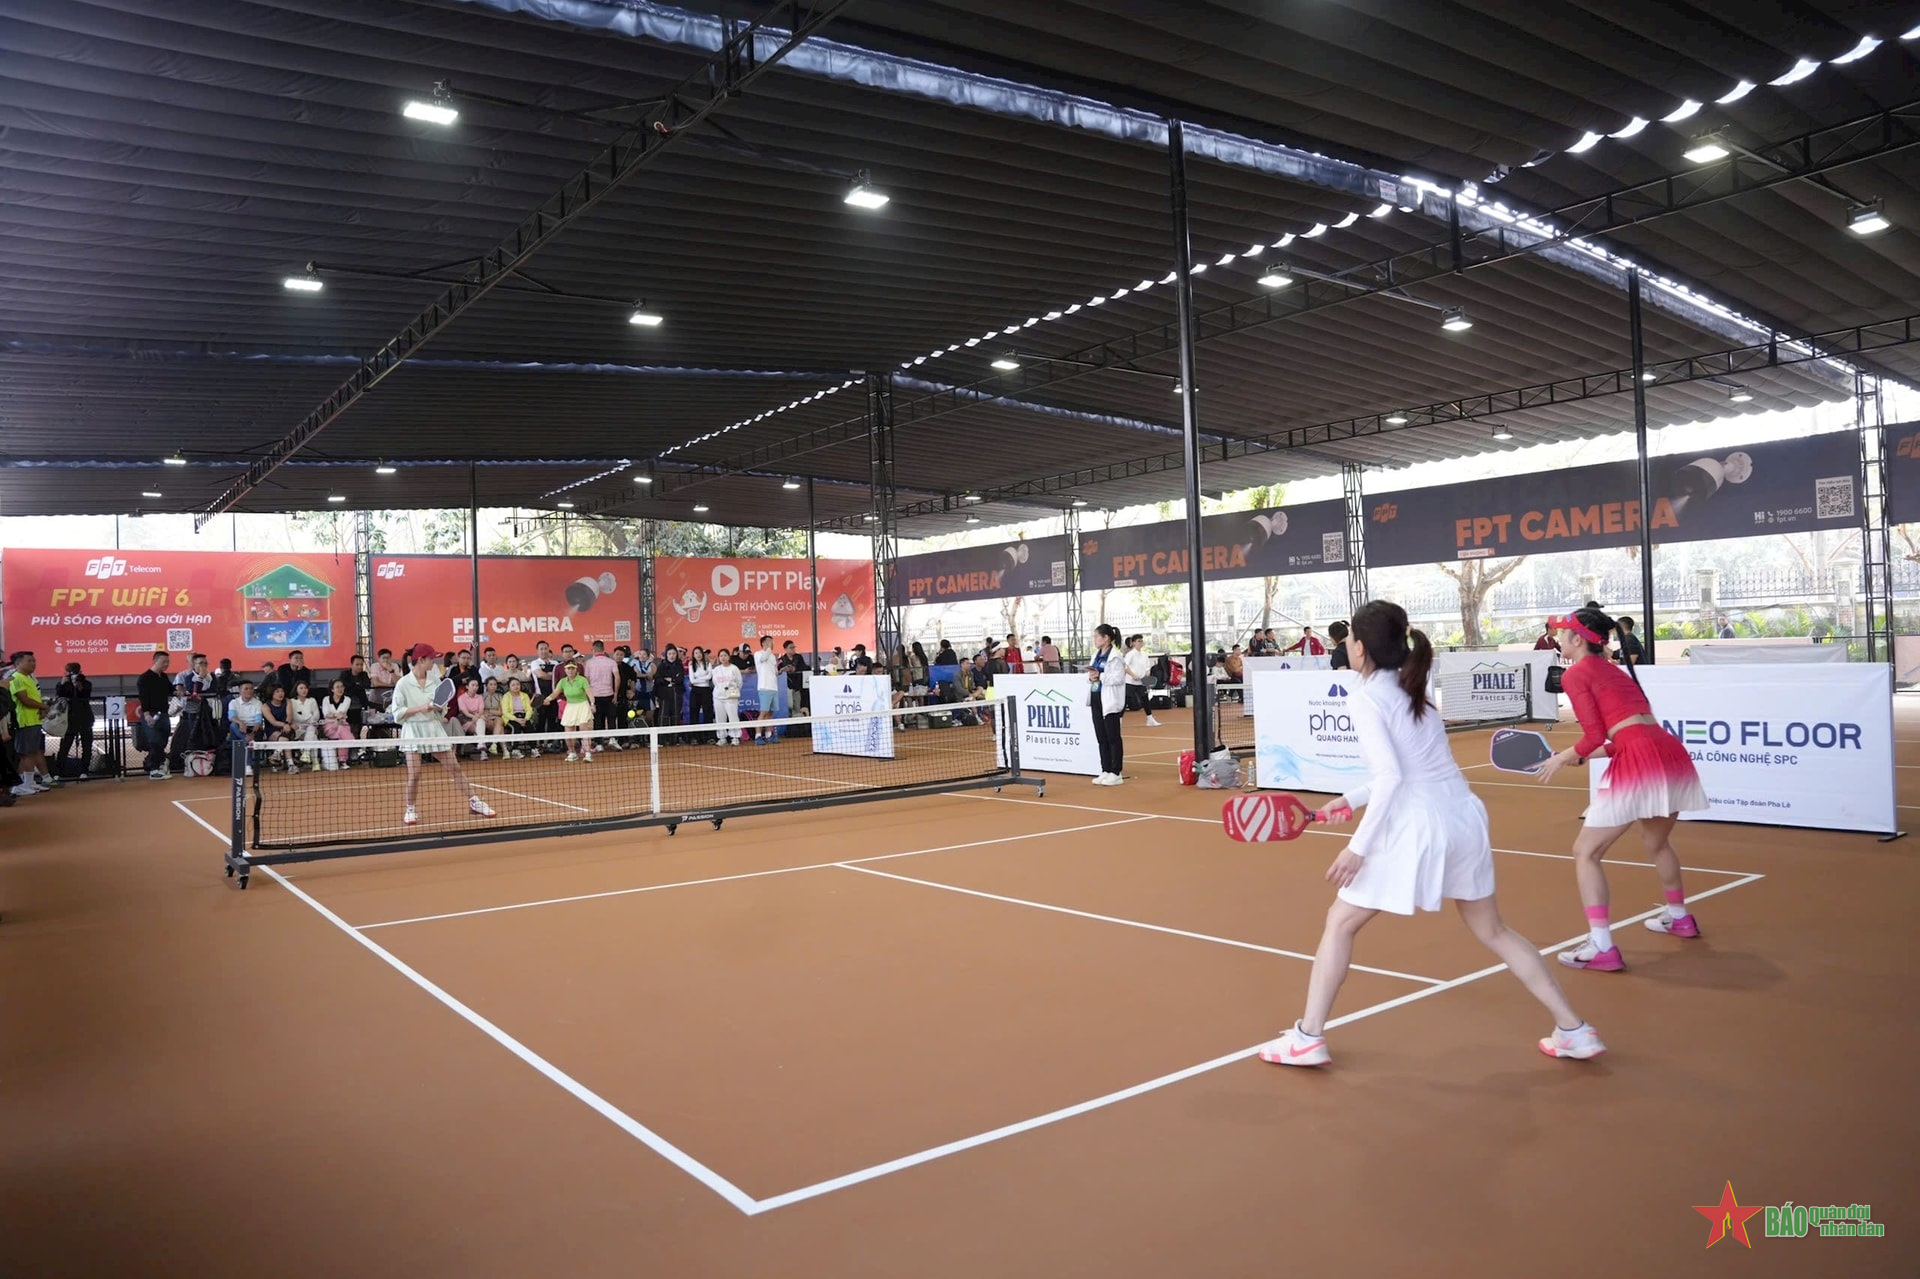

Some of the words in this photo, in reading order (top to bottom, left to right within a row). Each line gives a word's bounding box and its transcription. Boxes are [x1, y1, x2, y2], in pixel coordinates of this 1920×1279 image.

[1373, 503, 1397, 523] FPT
[1776, 508, 1793, 516] 1900
[1794, 506, 1813, 515] 6600
[1456, 514, 1512, 547] FPT
[1519, 496, 1679, 541] CAMERA
[85, 556, 127, 579] FPT
[129, 565, 162, 573] Telecom
[1112, 553, 1148, 578] FPT
[1152, 543, 1246, 576] CAERA
[377, 562, 405, 579] FPT
[744, 571, 782, 590] FPT
[786, 571, 826, 596] Play
[908, 577, 933, 597] FPT
[936, 570, 1001, 595] CAMERA
[50, 588, 104, 607] FPT
[111, 587, 169, 607] WiFi
[174, 587, 190, 607] 6
[713, 600, 732, 611] GIẢI
[735, 600, 749, 611] TRÍ
[750, 600, 784, 611] KHÔNG
[786, 600, 806, 611] GIỚI
[31, 613, 60, 626] PHỦ
[63, 613, 102, 625] SÓNG
[105, 613, 152, 625] KHÔNG
[155, 613, 183, 624] GIỚI
[186, 614, 212, 626] HẠN
[453, 617, 487, 634] FPT
[491, 616, 573, 634] CAMERA
[1473, 673, 1515, 690] PHALE
[111, 703, 120, 715] 2
[1027, 705, 1070, 728] PHALE
[1026, 735, 1060, 744] Plastics
[1064, 737, 1080, 745] JSC
[1316, 734, 1342, 742] QUANG
[1662, 719, 1731, 745] NEO
[1741, 721, 1862, 750] FLOOR
[1706, 750, 1737, 762] CÔNG
[1739, 751, 1771, 766] NGHỆ
[1774, 754, 1798, 765] SPC
